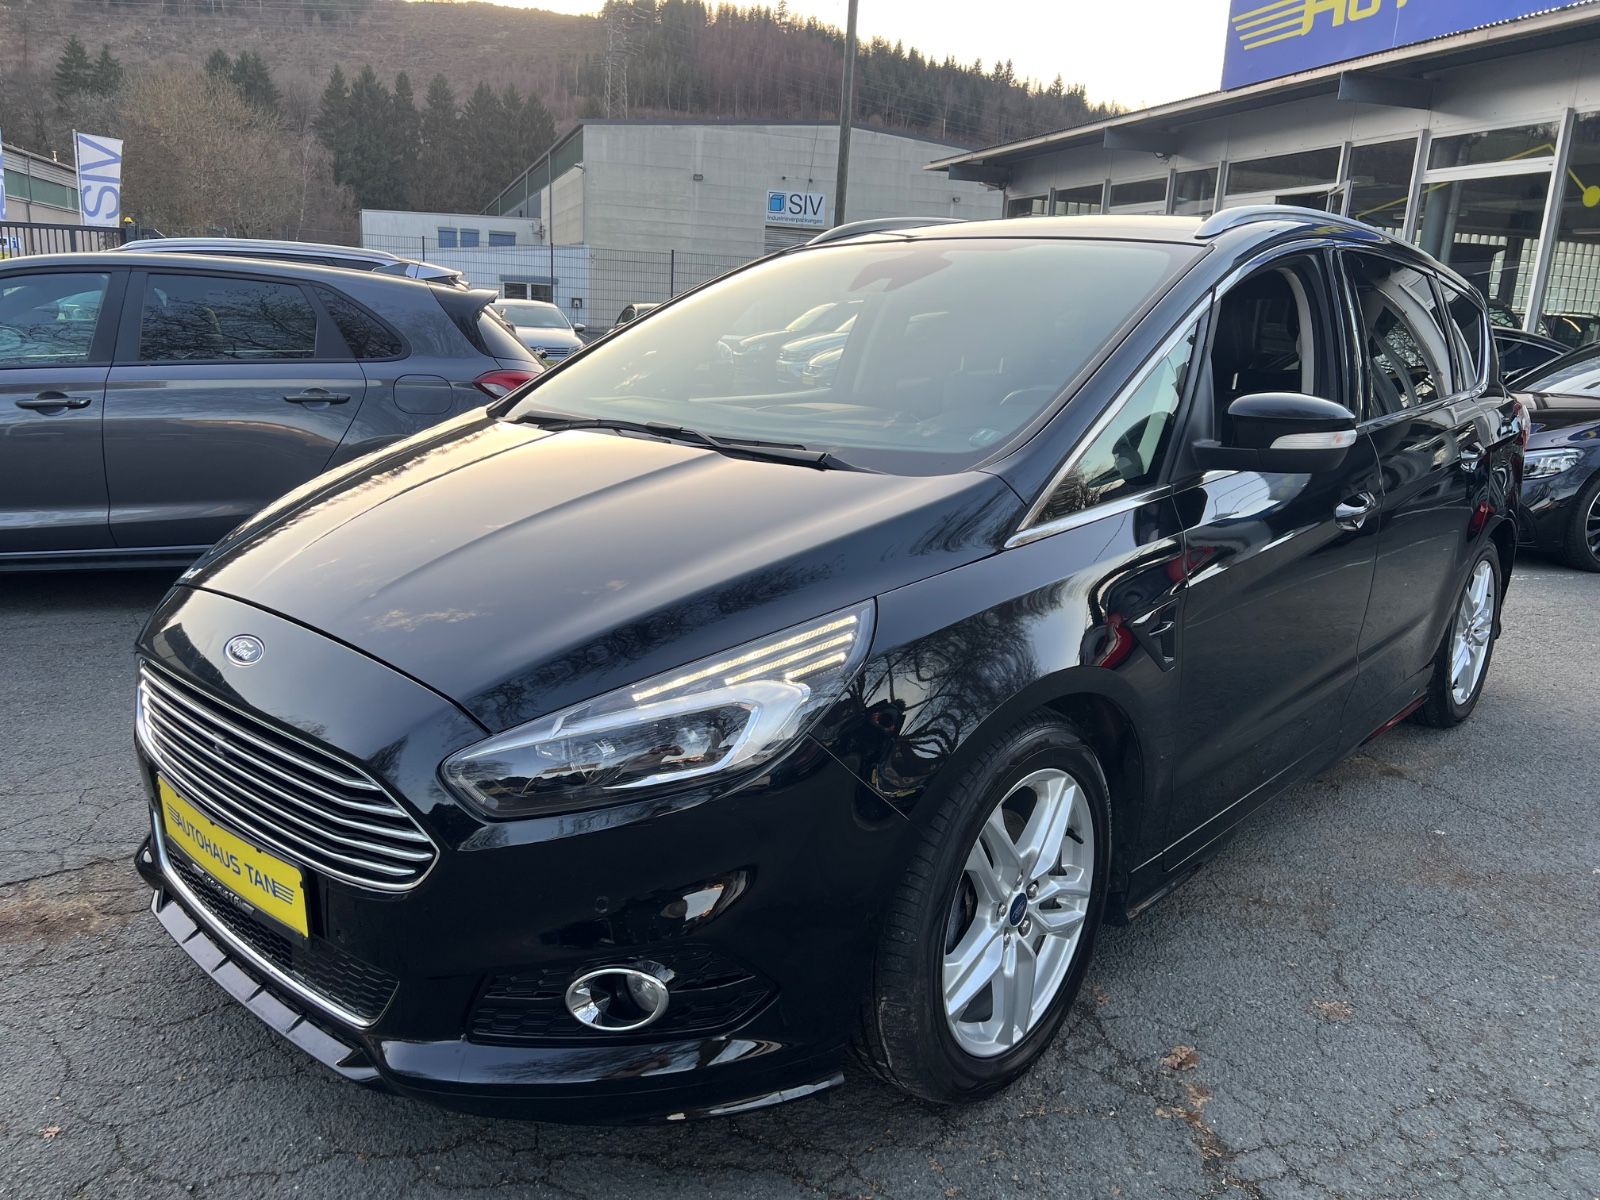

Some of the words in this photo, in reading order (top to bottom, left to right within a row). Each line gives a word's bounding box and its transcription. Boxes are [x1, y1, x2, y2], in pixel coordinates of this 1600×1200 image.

[79, 134, 122, 220] SIV
[788, 193, 824, 216] SIV
[176, 812, 241, 876] AUTOHAUS
[244, 863, 278, 898] TAN
